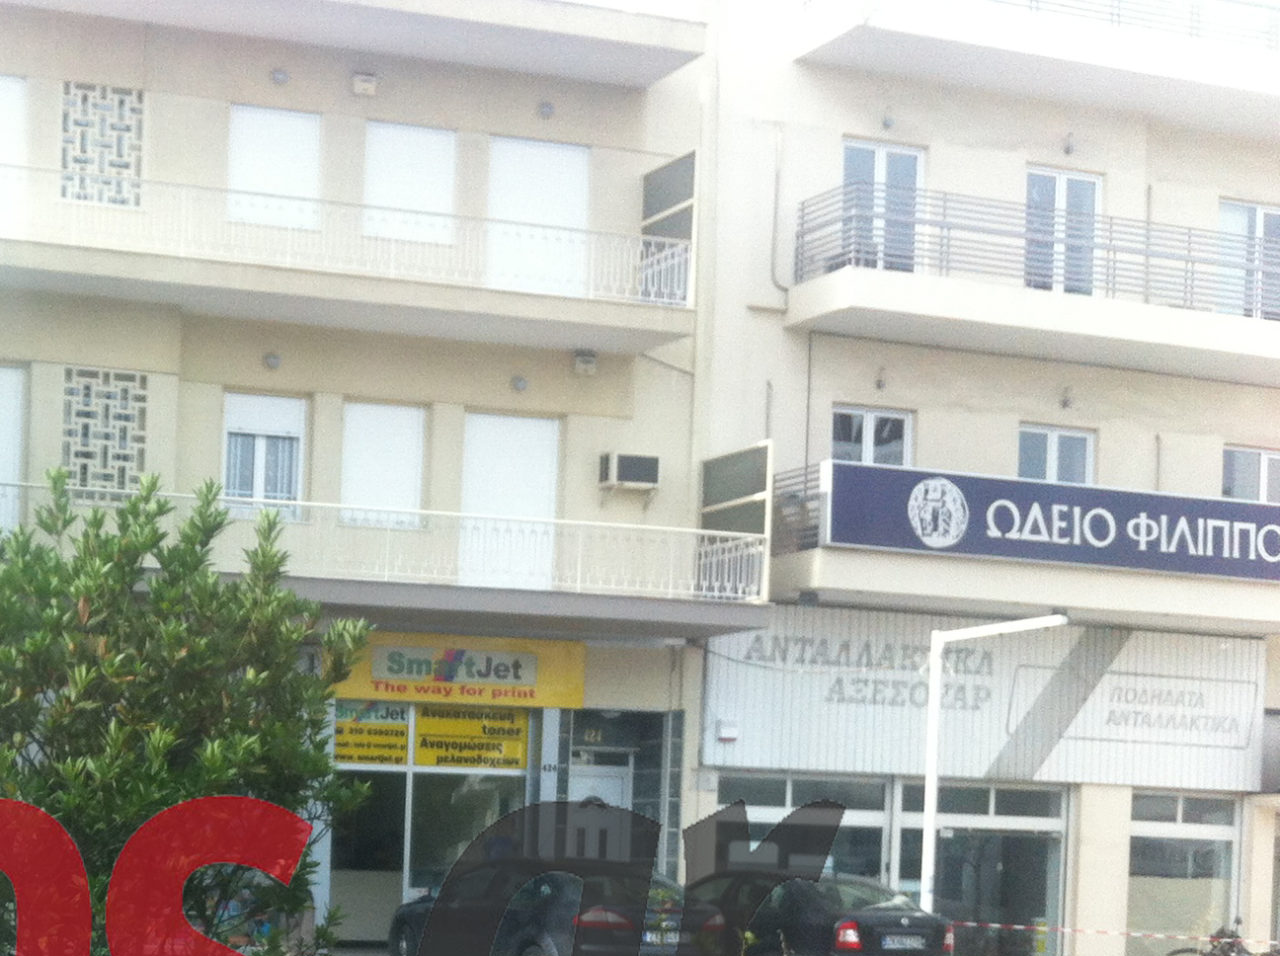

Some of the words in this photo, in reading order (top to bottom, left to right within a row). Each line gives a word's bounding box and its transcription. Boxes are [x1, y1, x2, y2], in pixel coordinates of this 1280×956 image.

[986, 499, 1116, 548] ΩΔΕΙΟ
[386, 650, 523, 681] SmartJet
[371, 680, 408, 694] The
[414, 684, 453, 698] way
[459, 684, 486, 696] for
[491, 687, 537, 700] print
[481, 724, 522, 737] toner
